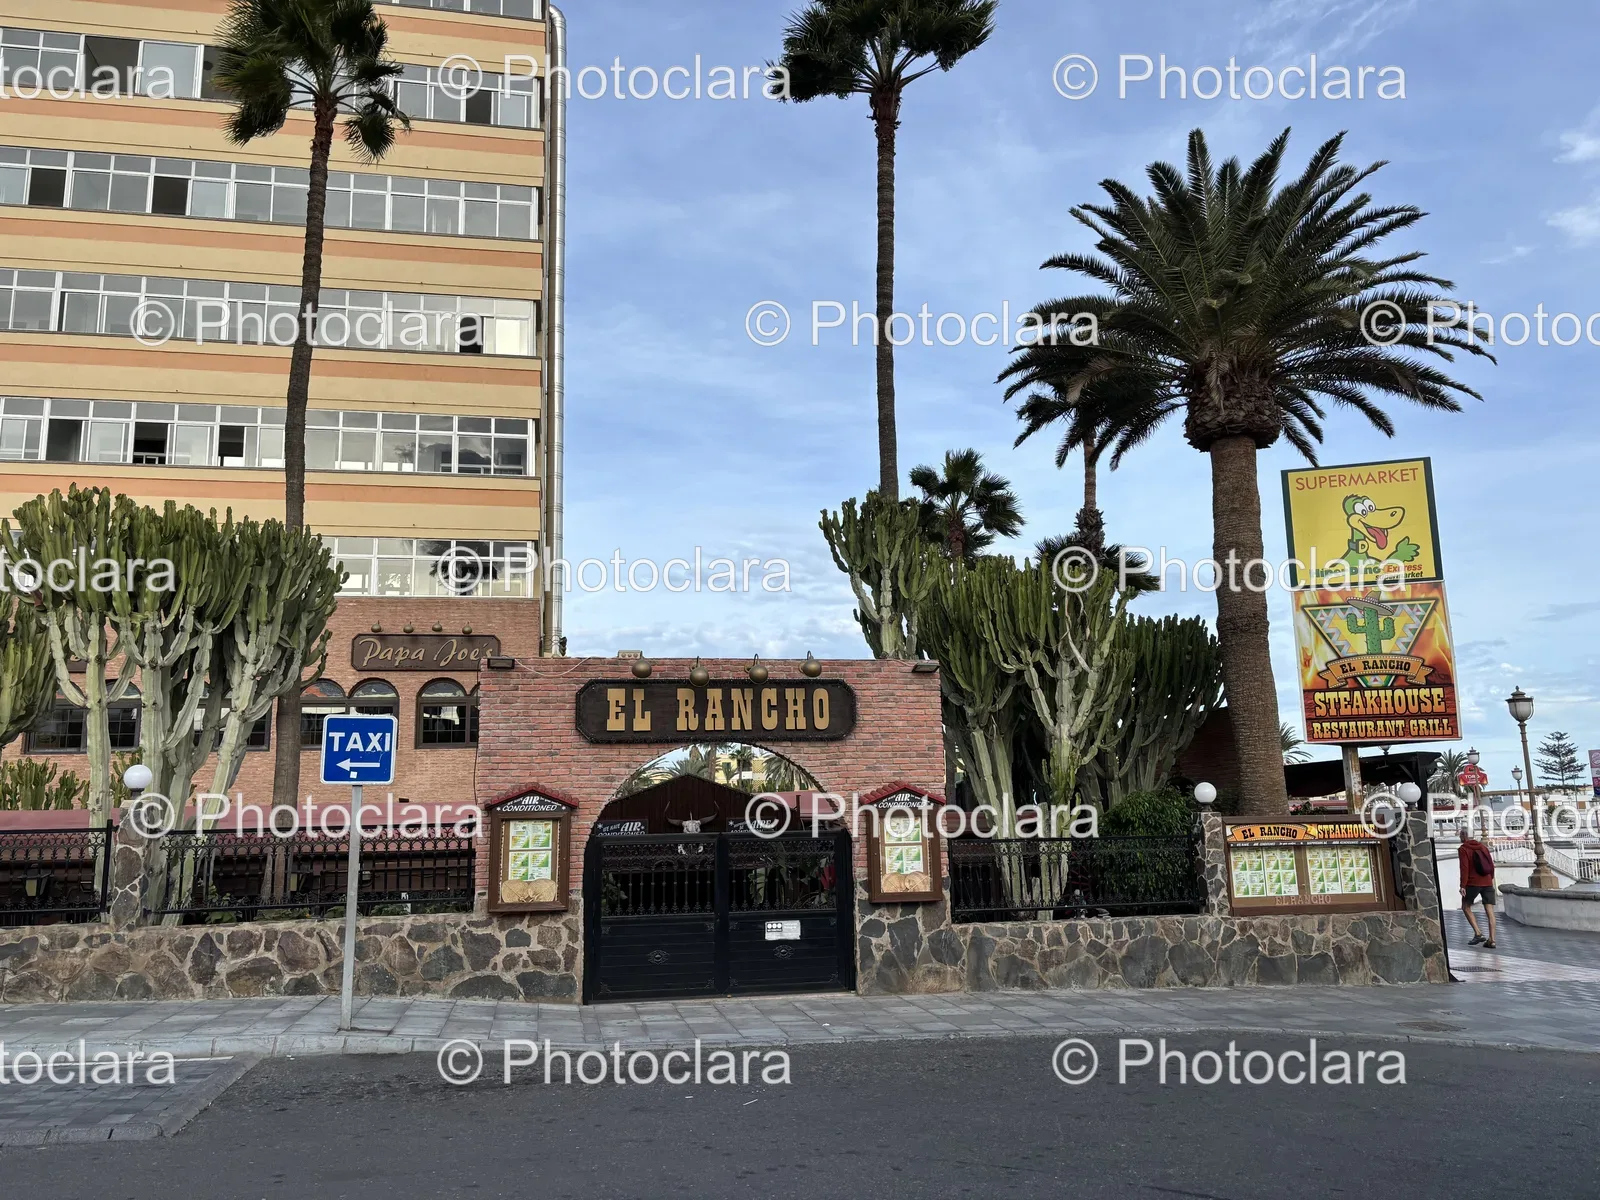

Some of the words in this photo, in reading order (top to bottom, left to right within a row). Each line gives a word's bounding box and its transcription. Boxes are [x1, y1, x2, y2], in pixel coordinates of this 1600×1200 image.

[1295, 467, 1419, 491] SUPERMARKET
[358, 637, 426, 667] Papa
[433, 638, 493, 667] Joe's
[1339, 663, 1356, 674] EL
[1363, 659, 1411, 671] RANCHO
[606, 688, 651, 731] EL
[676, 687, 830, 731] RANCHO
[1313, 687, 1446, 717] STEAKHOUSE
[1312, 719, 1405, 739] RESTAURANT
[1409, 718, 1453, 736] GRILL
[328, 732, 391, 752] TAXI
[521, 795, 540, 805] AIR
[894, 793, 911, 802] AIR
[502, 804, 558, 812] CONDITIONED
[620, 821, 642, 832] AIR
[1241, 828, 1255, 840] EL
[1260, 826, 1298, 839] RANCHO
[1317, 823, 1376, 839] STEAKHOUSE
[1275, 896, 1289, 906] EL
[1290, 894, 1331, 905] RANCHO
